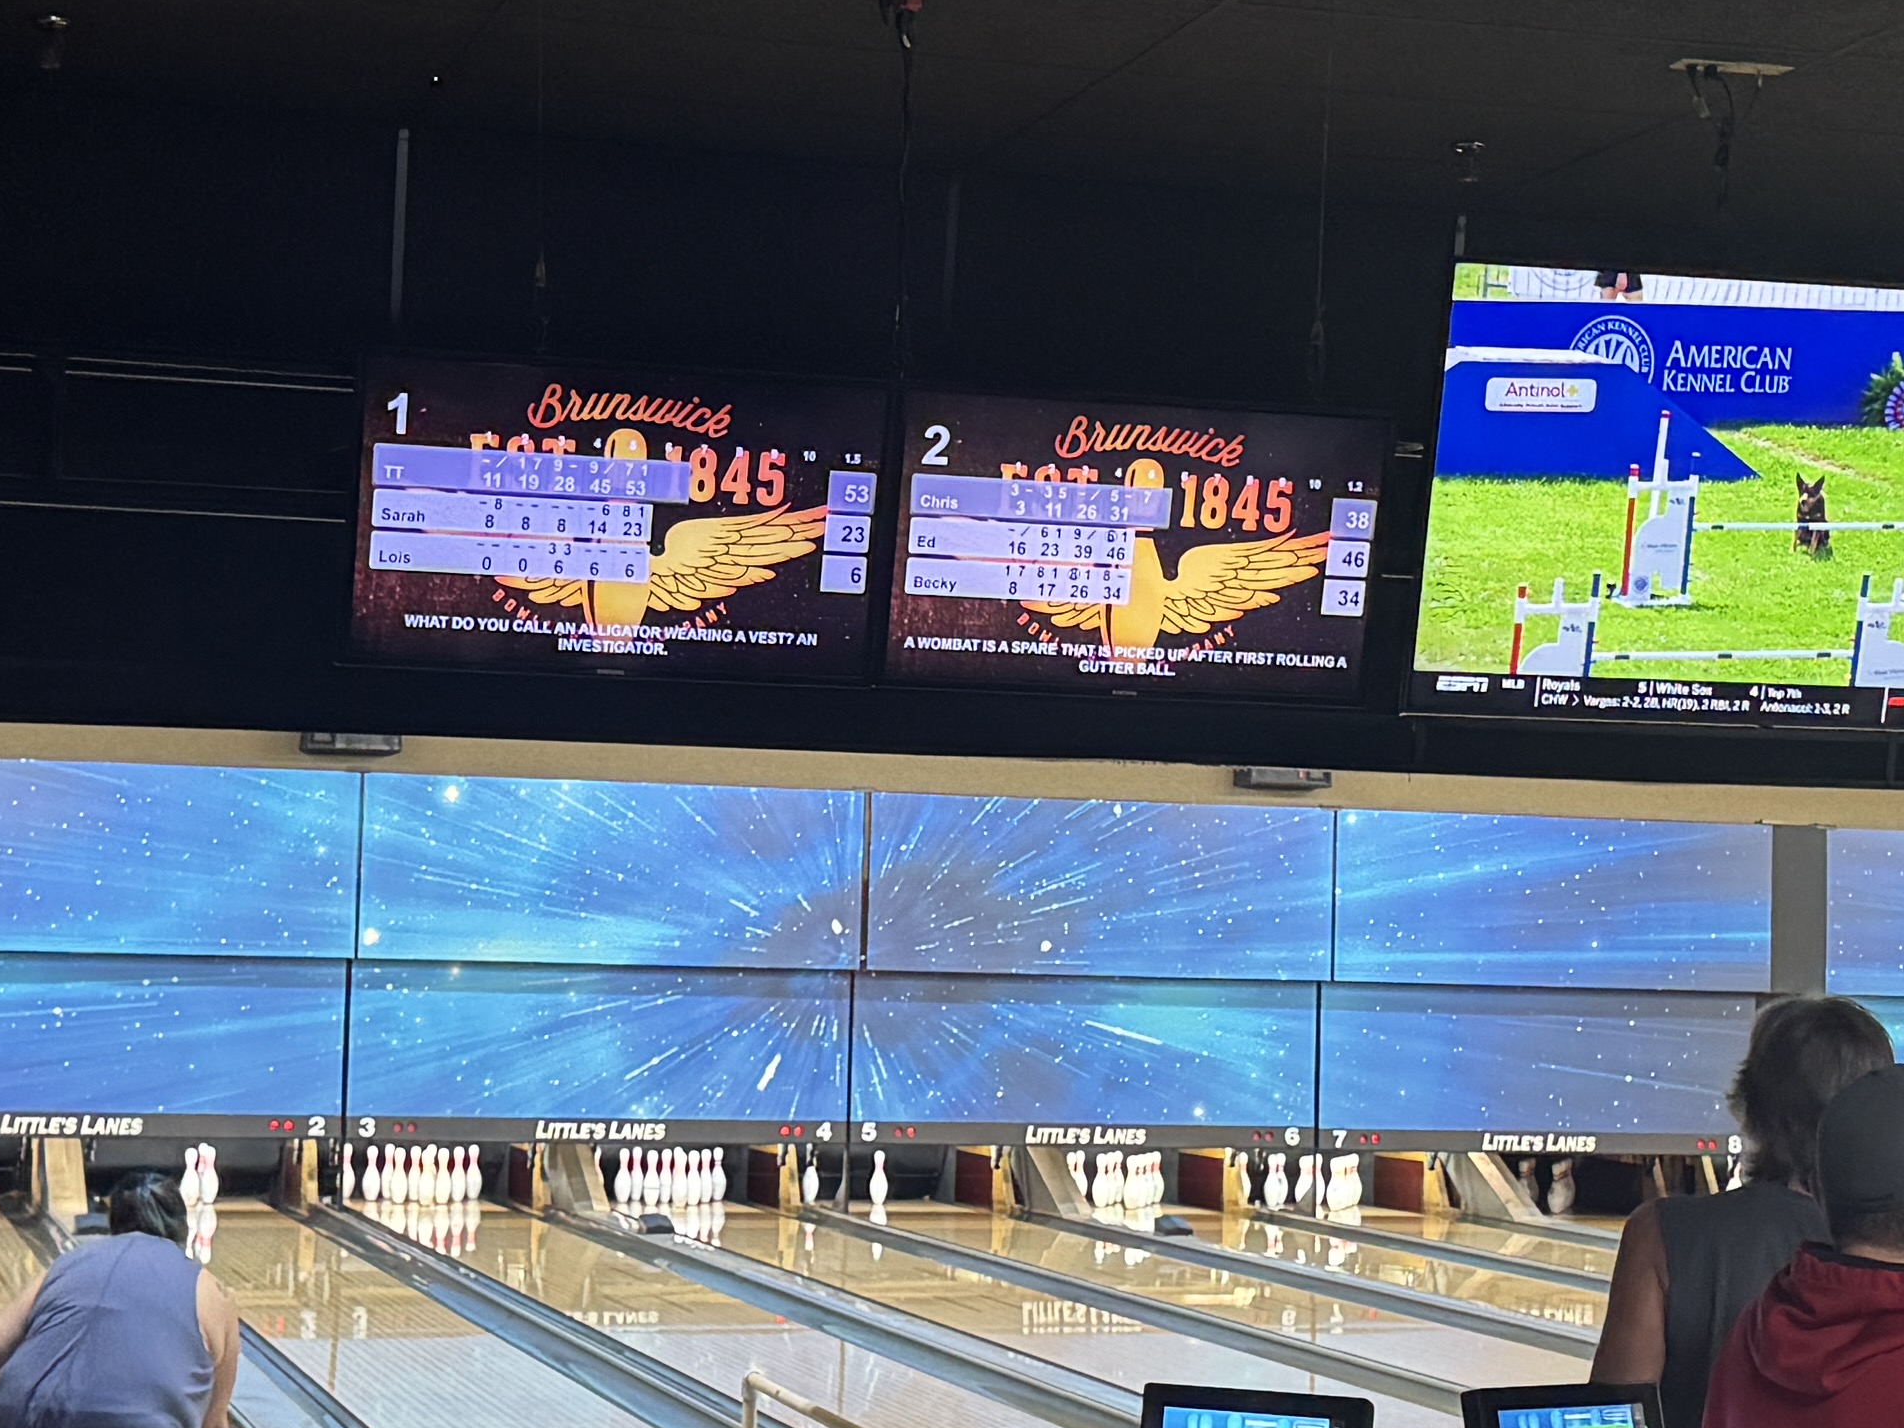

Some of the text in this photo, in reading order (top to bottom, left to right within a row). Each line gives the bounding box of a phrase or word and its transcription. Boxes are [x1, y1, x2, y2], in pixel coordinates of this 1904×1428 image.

[1665, 340, 1793, 370] AMERICAN
[1662, 369, 1791, 393] KENNEL CLUB
[387, 392, 408, 435] 1
[527, 383, 733, 439] Brunswick
[921, 424, 951, 466] 2
[1055, 415, 1246, 468] Brunswick
[483, 472, 646, 496] 11 19 28 45 53
[844, 484, 871, 503] 53
[919, 493, 959, 510] Chris
[1179, 473, 1294, 533] 1845
[381, 507, 426, 524] Sarah
[1077, 503, 1129, 522] 26 31
[1345, 511, 1370, 529] 38
[588, 520, 643, 538] 14 23
[840, 525, 865, 544] 23
[916, 535, 936, 549] Ed
[1008, 541, 1126, 561] 16 23 39 46
[379, 549, 411, 565] Lois
[1342, 551, 1365, 568] 46
[850, 566, 862, 584] 6
[912, 576, 958, 592] Becky
[1037, 583, 1121, 600] 17 26 34
[1337, 590, 1360, 607] 34
[404, 614, 818, 646] WHAT DO YOU CALL AN ALLIGATOR WEARING A VEST? AN
[557, 636, 669, 656] INVESTIGATOR.
[903, 636, 1347, 669] A WOMBAT IS A SPARE THAT IS PICKED UP AFTER FIRST ROLLING A
[1078, 659, 1176, 677] GUTTER BALL.
[1436, 675, 1489, 693] ESPN
[1542, 677, 1581, 692] Royals
[1656, 682, 1713, 696] White Sox
[0, 1113, 144, 1136] LITTLE'S LANES
[307, 1115, 326, 1137] 2
[357, 1116, 377, 1138] 3
[535, 1119, 667, 1141] LITTLE'S LANES
[815, 1121, 833, 1142] 4
[860, 1121, 878, 1142] 5
[1025, 1124, 1147, 1146] LITTLE'S LANES
[1284, 1126, 1301, 1147] 6
[1331, 1129, 1348, 1149] 7
[1481, 1132, 1597, 1153] LITTLE'S LANES
[1727, 1134, 1744, 1154] 8
